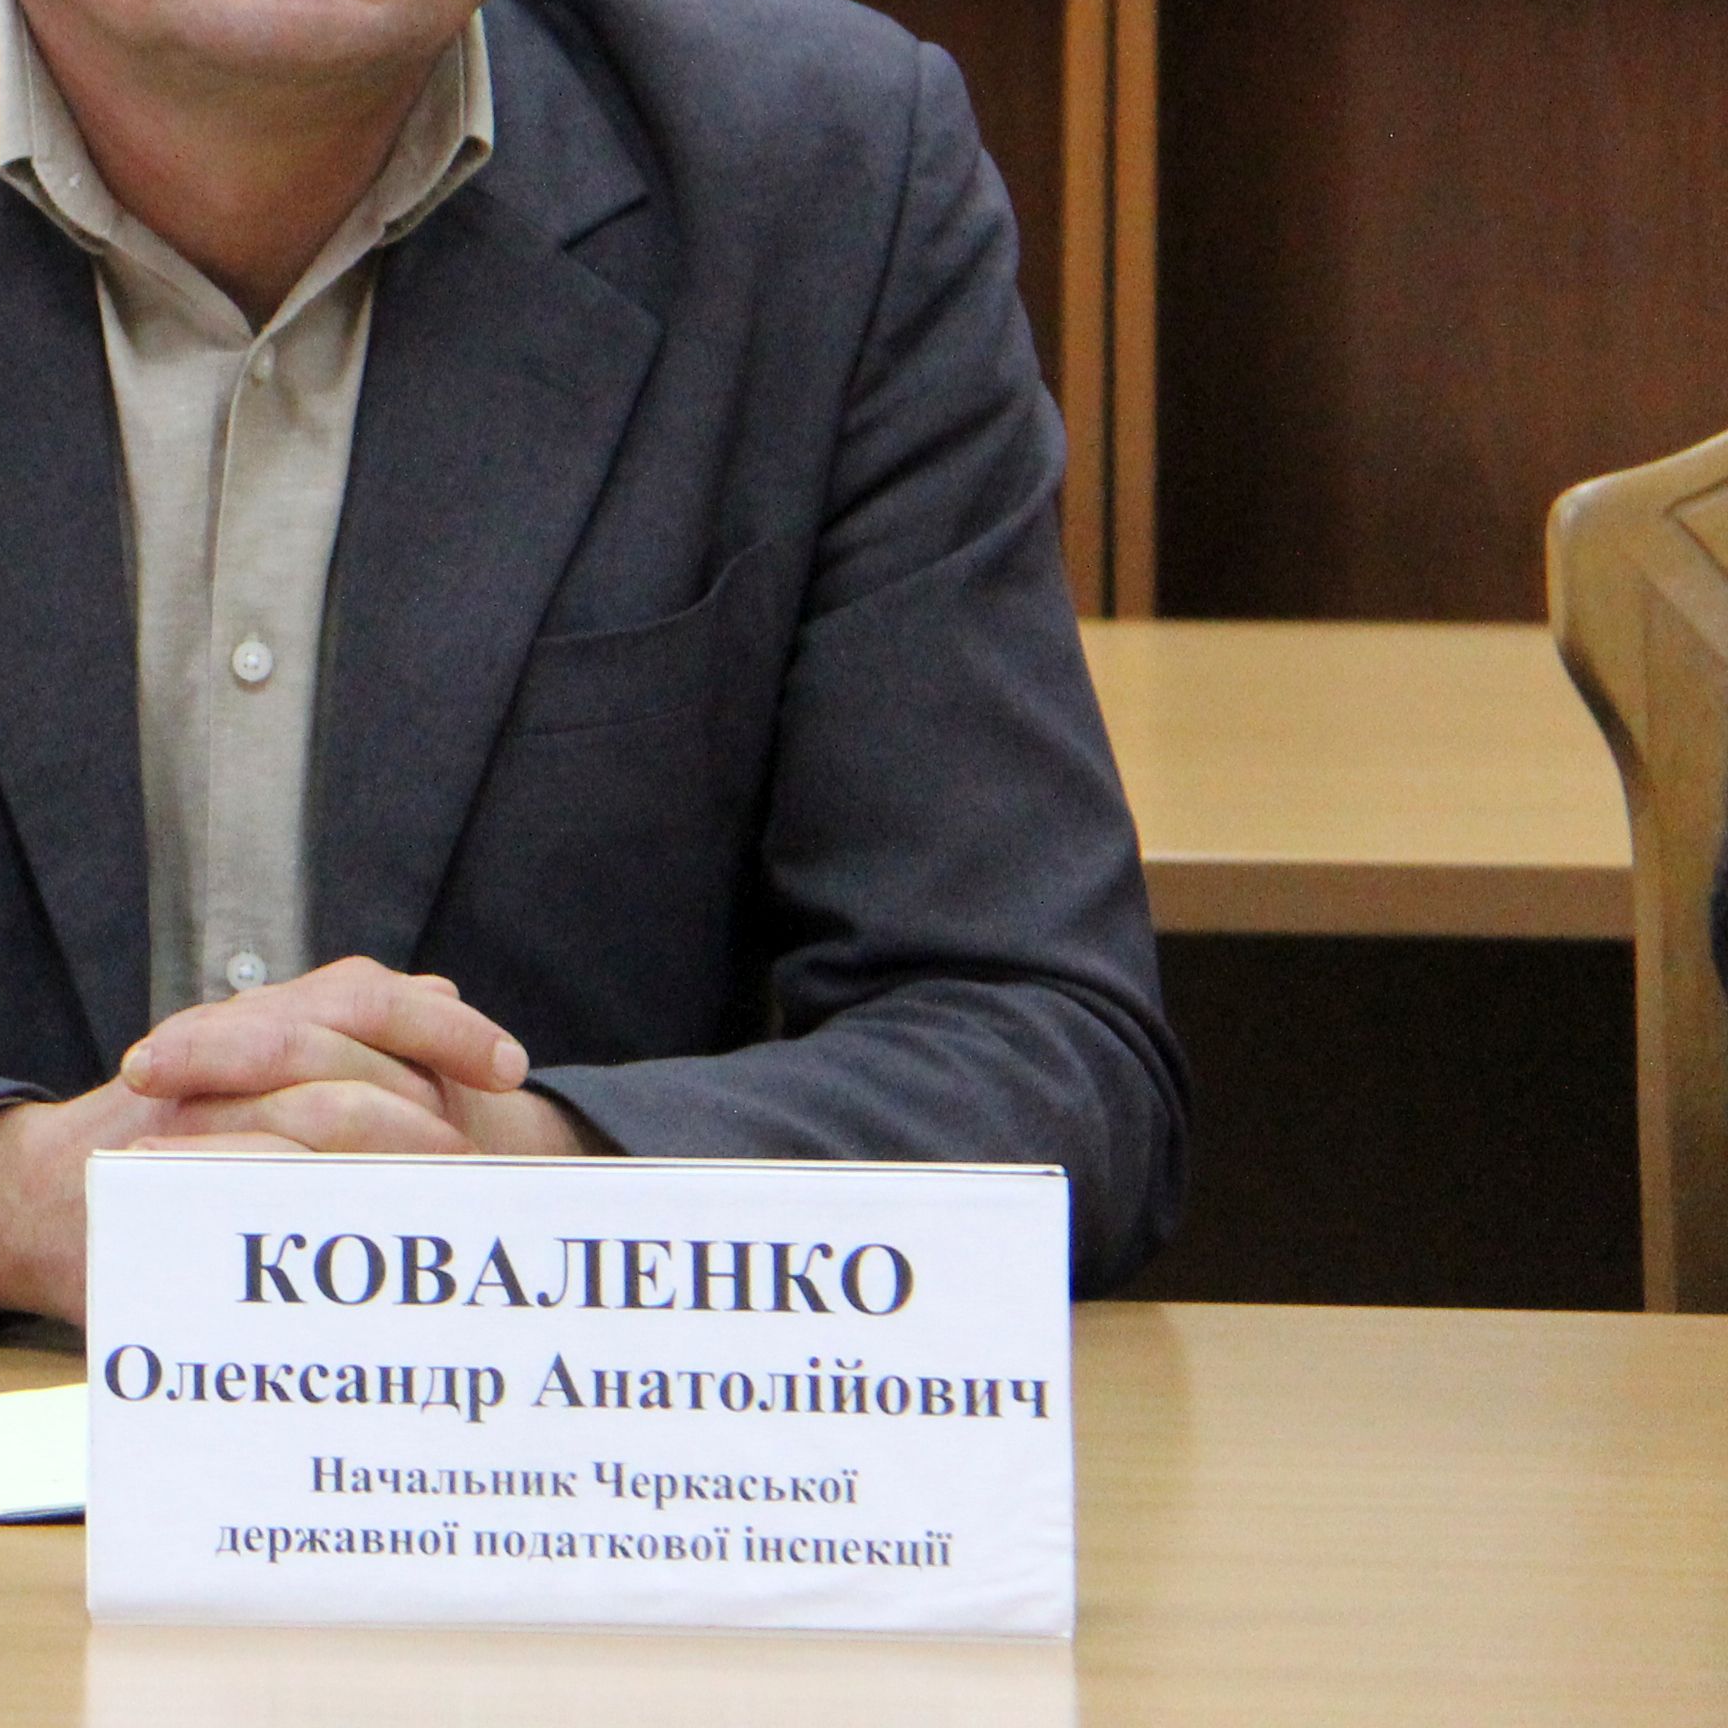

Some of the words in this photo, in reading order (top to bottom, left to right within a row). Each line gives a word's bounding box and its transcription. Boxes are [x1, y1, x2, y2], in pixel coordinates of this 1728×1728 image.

[236, 1232, 915, 1317] КОВАЛЕНКО
[103, 1344, 506, 1424] Олександр
[530, 1351, 1049, 1420] Анатолійович
[311, 1456, 578, 1498] Начальник
[592, 1461, 859, 1511] Черкаської
[215, 1520, 460, 1564] державної
[473, 1526, 731, 1562] податкової
[743, 1525, 953, 1569] інспекції
